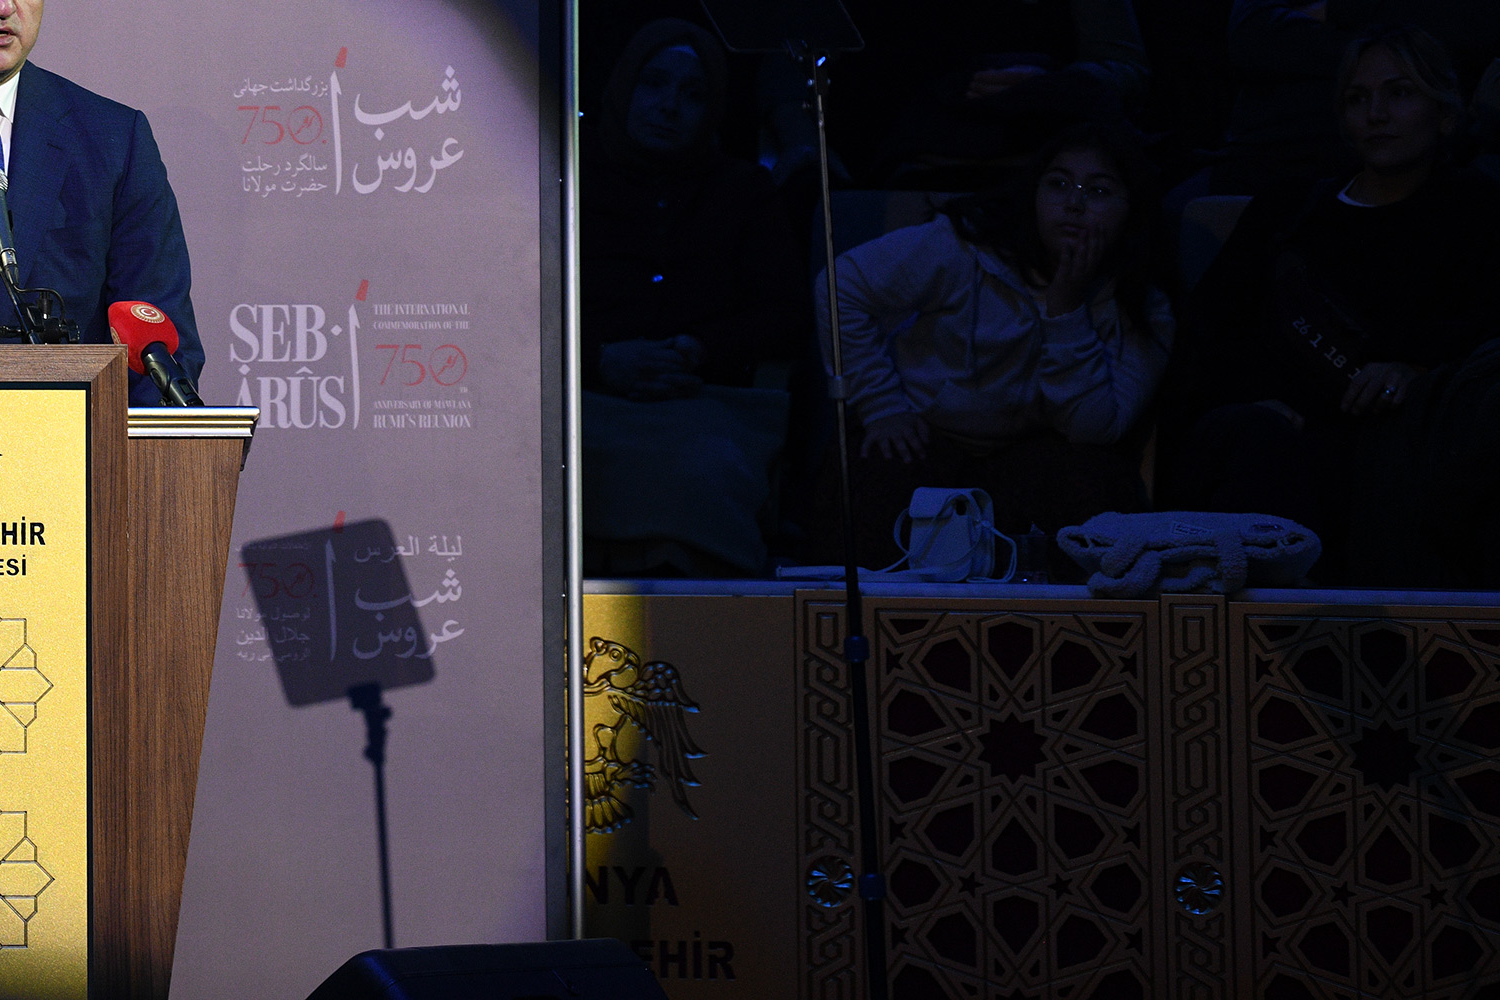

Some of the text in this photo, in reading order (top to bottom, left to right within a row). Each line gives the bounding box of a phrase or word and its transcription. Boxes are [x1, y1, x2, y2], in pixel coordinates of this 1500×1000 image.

[352, 137, 464, 194] عروس
[395, 303, 470, 316] INTERNATIONAL
[1324, 345, 1348, 368] 18
[418, 413, 472, 429] REUNION
[585, 865, 679, 906] NYA
